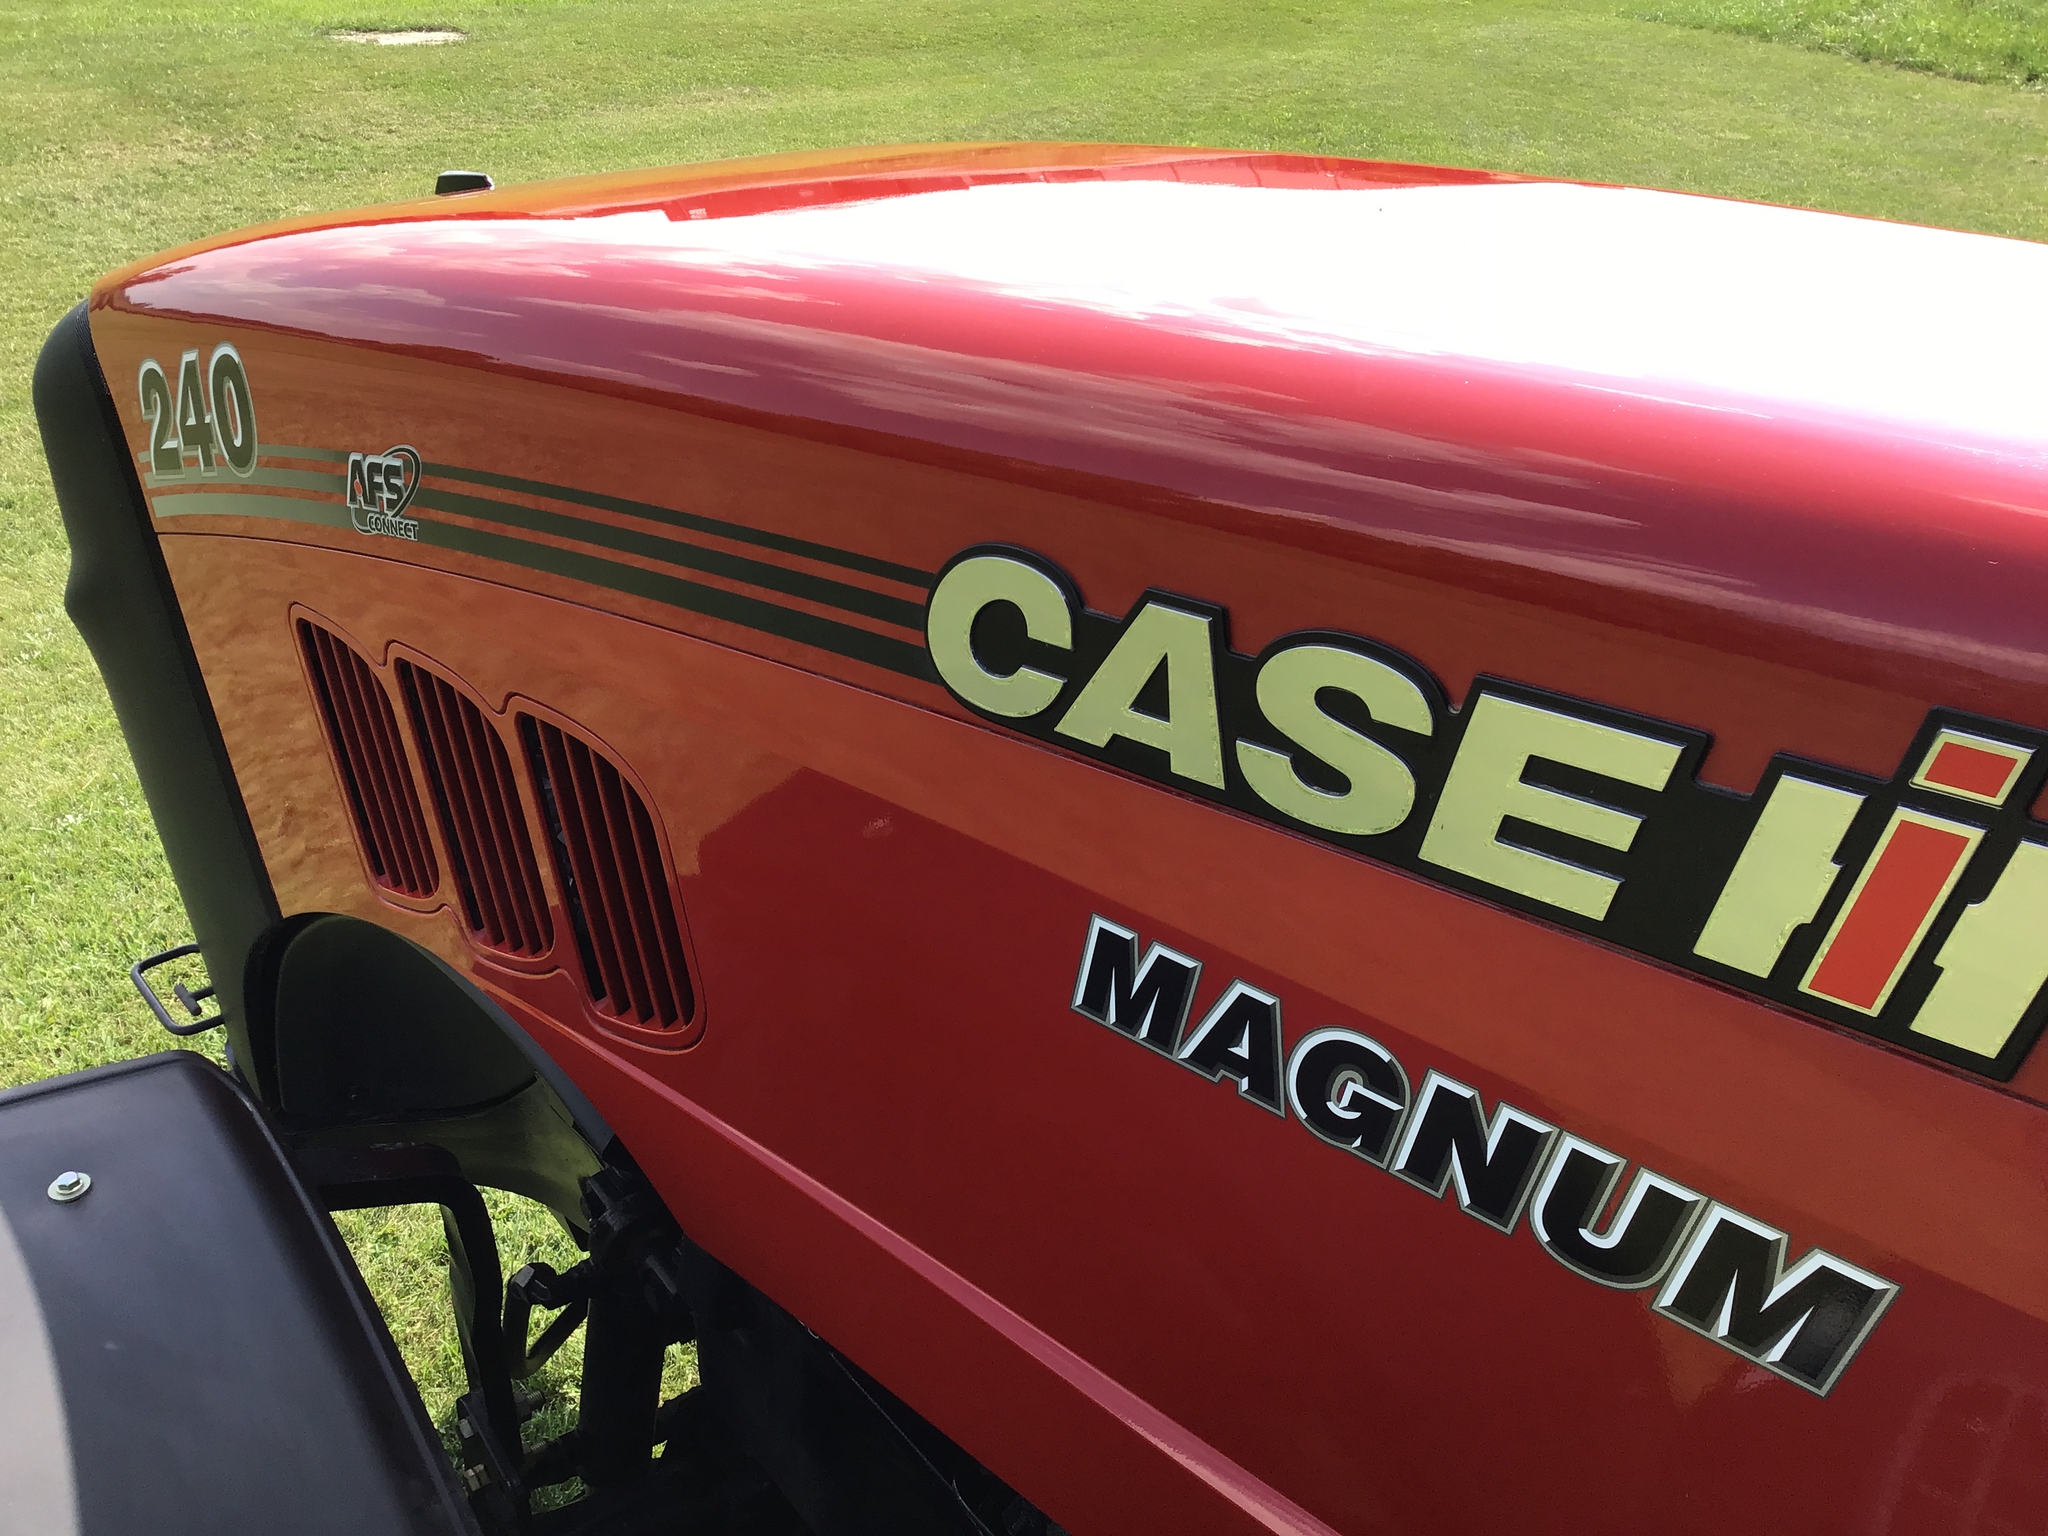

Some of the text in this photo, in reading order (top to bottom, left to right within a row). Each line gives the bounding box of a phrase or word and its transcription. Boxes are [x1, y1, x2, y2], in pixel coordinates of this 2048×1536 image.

[139, 342, 257, 478] 240
[347, 452, 404, 514] AFS
[367, 514, 419, 541] CONNECT
[926, 554, 1686, 921] CASE
[1070, 912, 1900, 1397] MAGNUM
